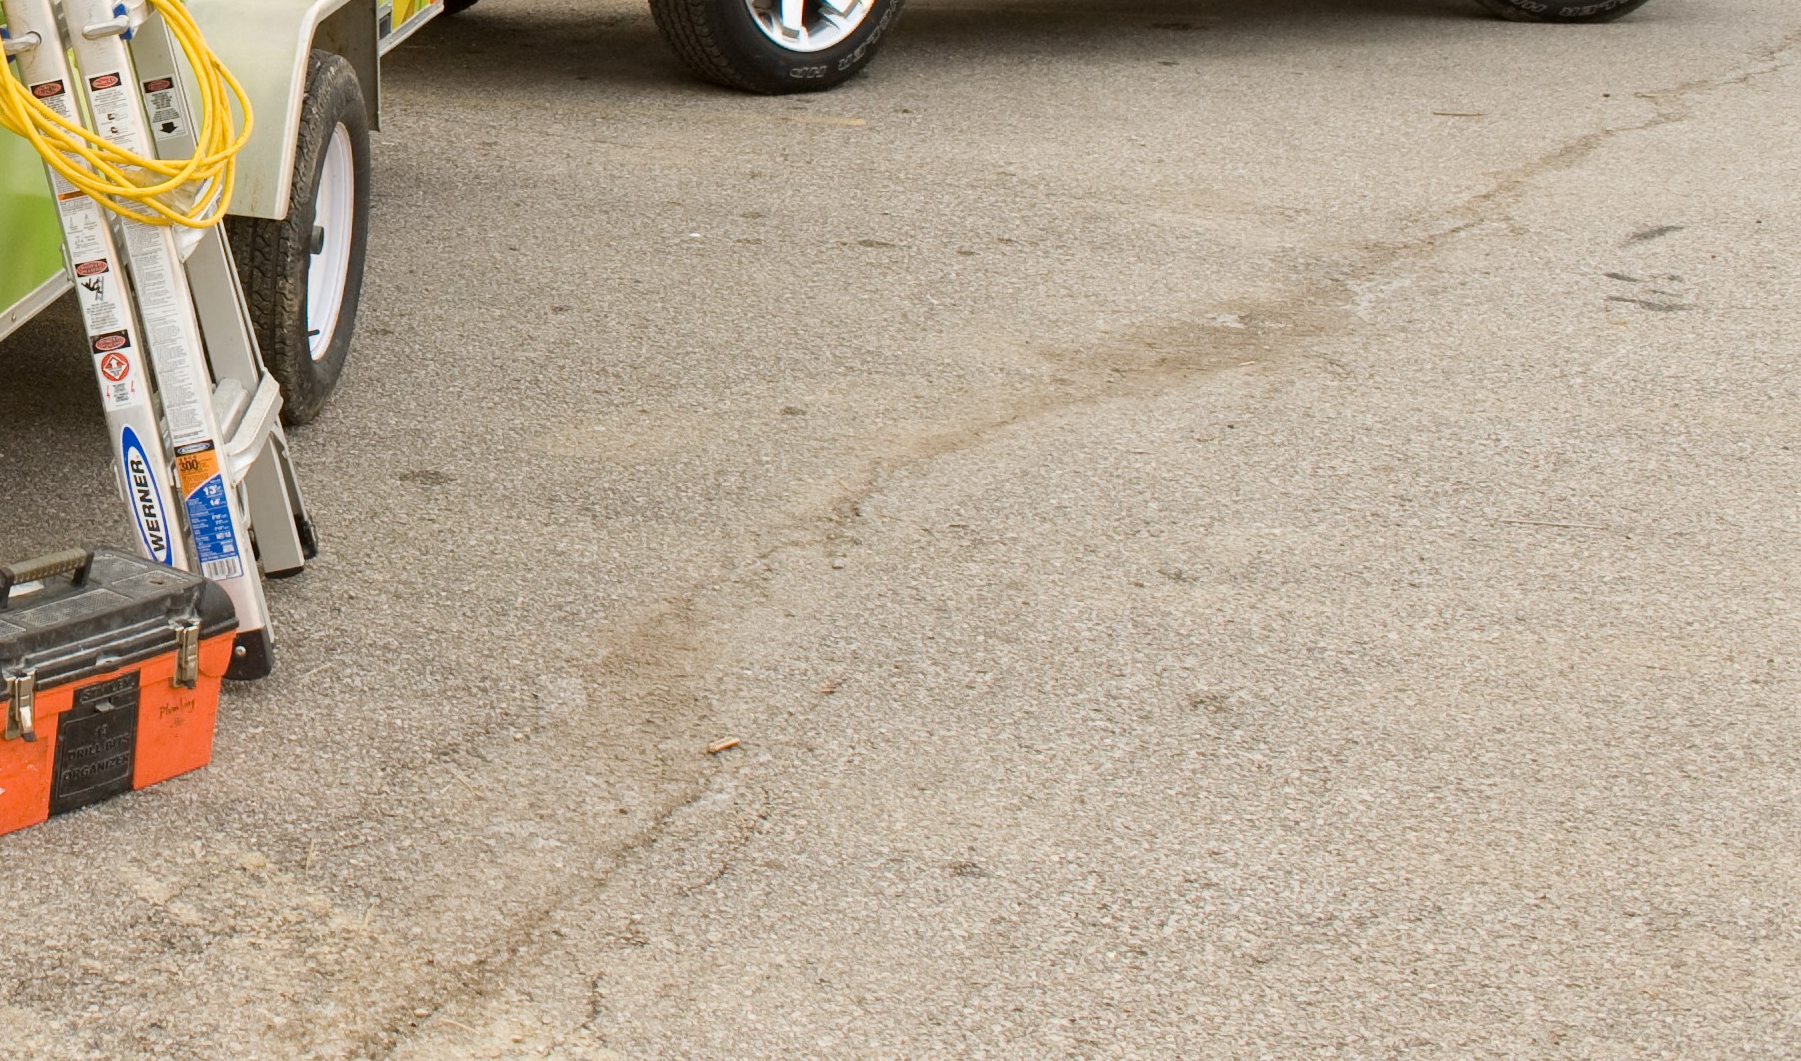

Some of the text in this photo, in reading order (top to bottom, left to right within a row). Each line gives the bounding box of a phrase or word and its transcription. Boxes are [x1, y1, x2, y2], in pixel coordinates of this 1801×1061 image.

[130, 459, 165, 552] WERNER
[67, 743, 101, 761] DRILL
[62, 753, 130, 781] ORGANIZER
